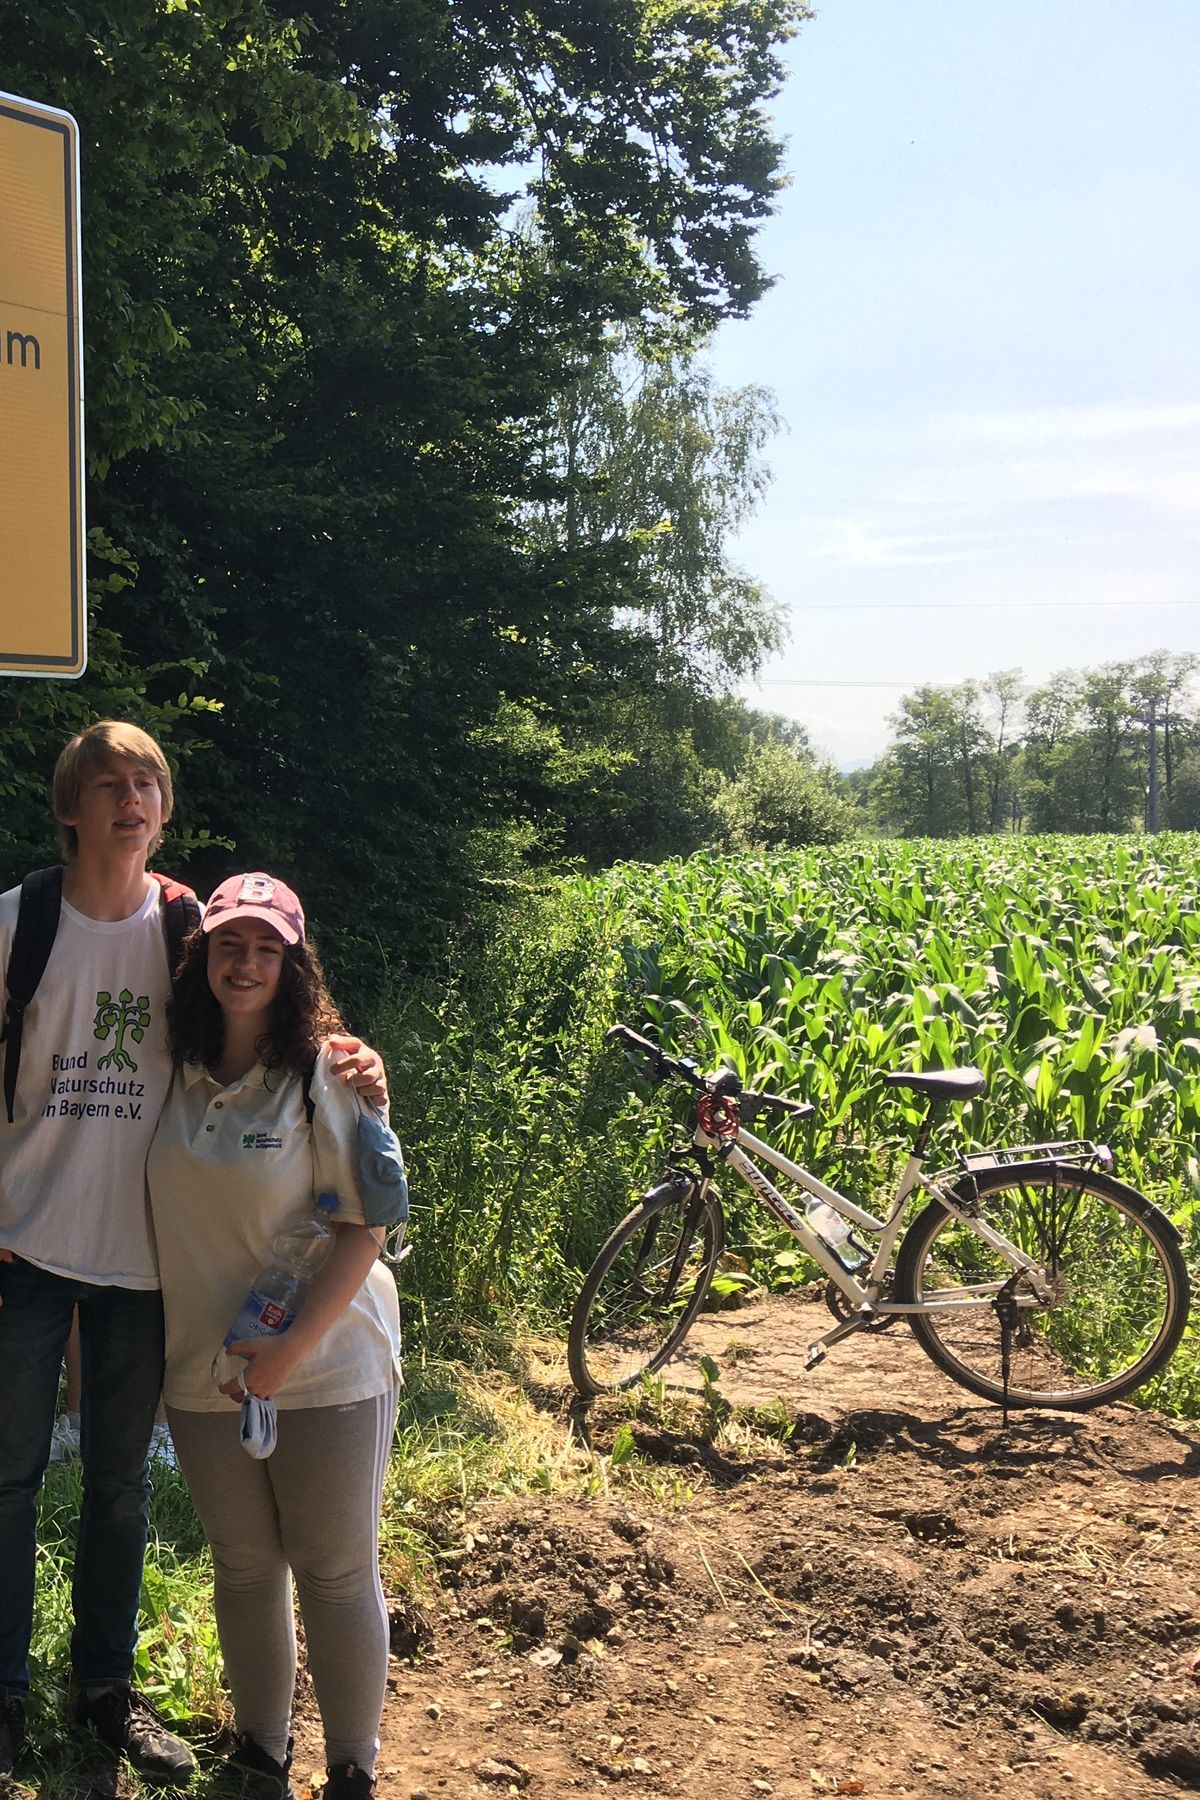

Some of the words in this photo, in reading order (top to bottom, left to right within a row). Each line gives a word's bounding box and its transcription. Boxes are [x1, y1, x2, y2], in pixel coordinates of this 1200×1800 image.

[238, 873, 276, 902] B
[52, 1051, 88, 1071] Bund
[114, 1102, 142, 1120] e.V.
